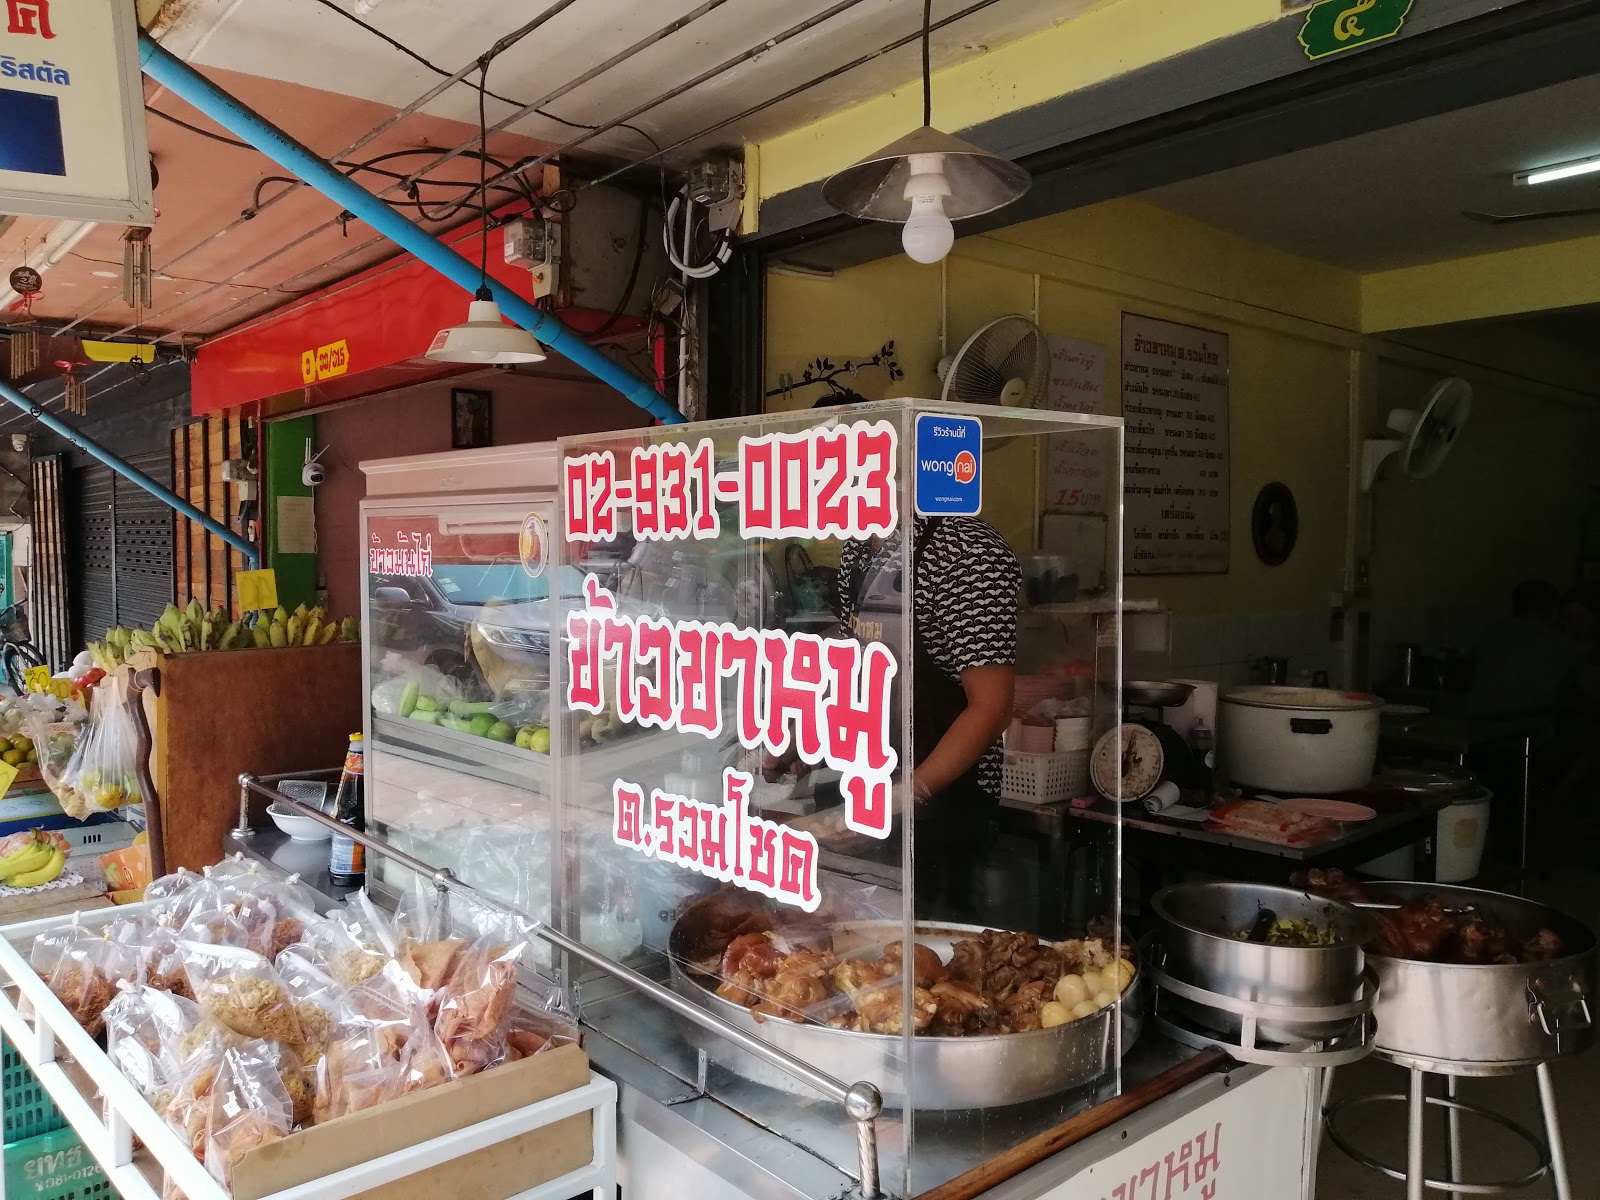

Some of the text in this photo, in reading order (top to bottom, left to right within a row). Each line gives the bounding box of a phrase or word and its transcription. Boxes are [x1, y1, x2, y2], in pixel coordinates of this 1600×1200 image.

[565, 424, 895, 539] 02-931-0023
[369, 531, 433, 578] ข้าวมันไก่
[568, 575, 894, 835] ข้าวขาหมู
